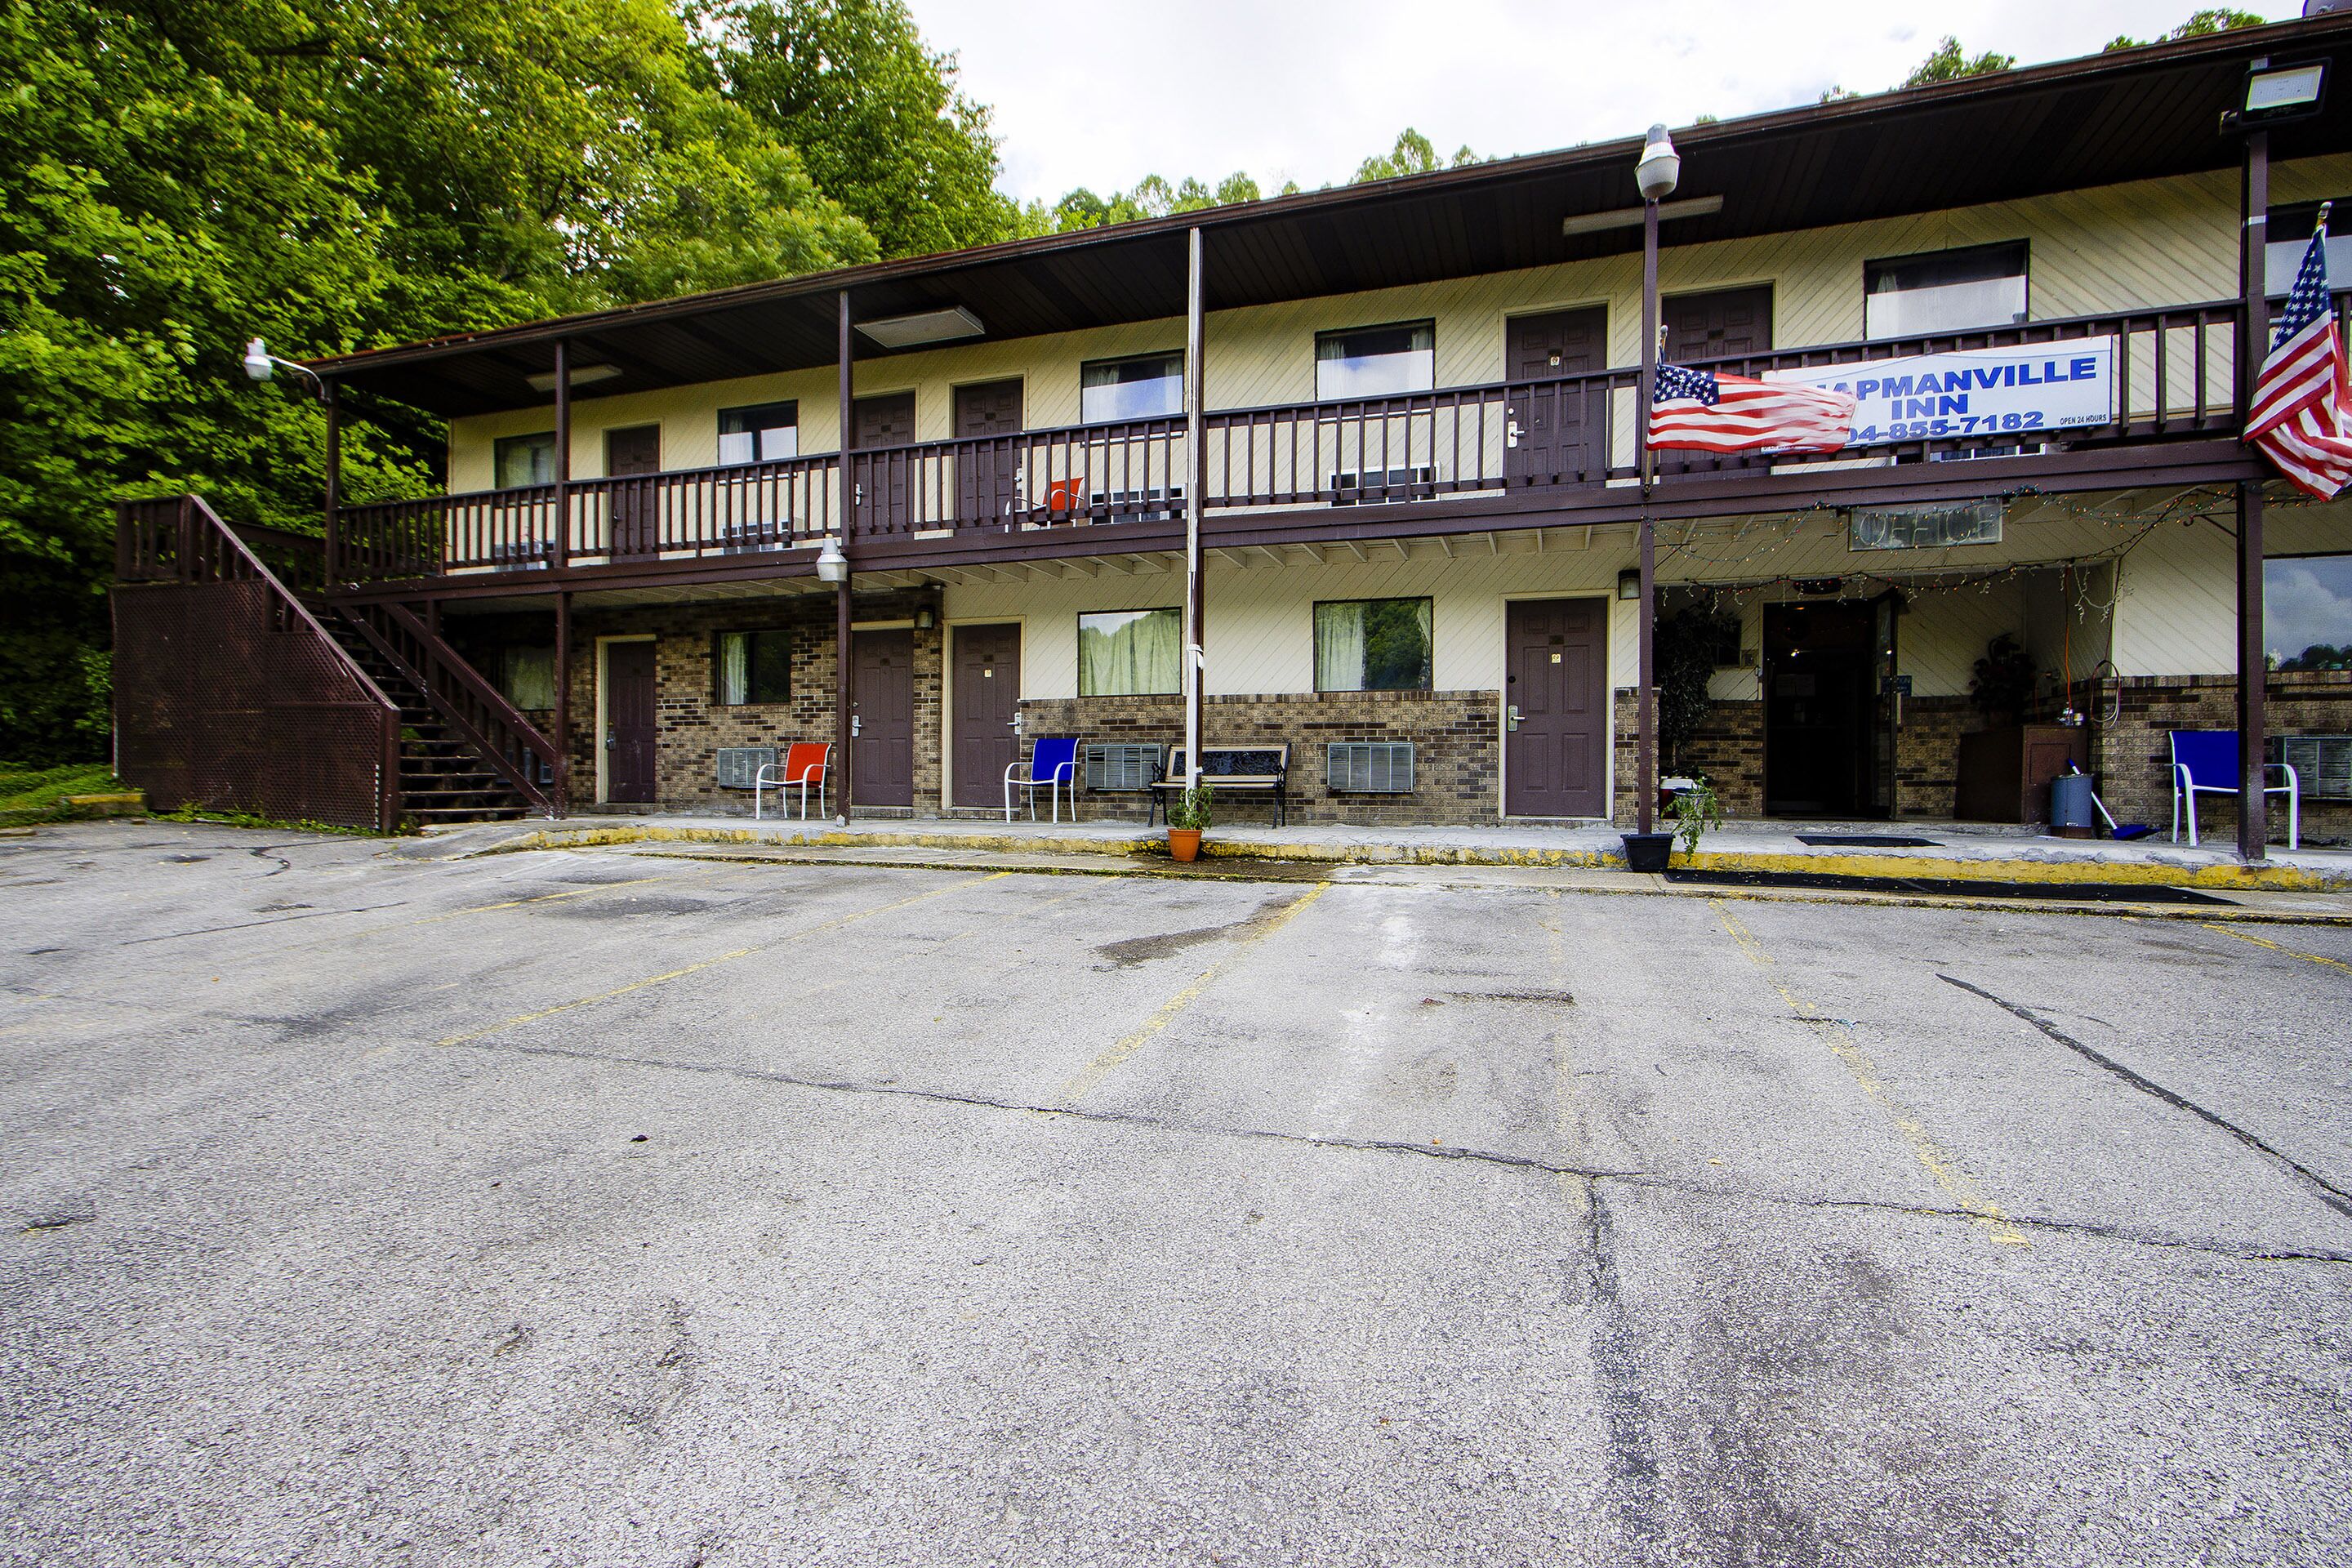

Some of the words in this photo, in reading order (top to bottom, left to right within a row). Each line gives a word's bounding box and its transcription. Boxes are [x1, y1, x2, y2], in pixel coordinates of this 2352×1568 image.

[1817, 357, 2096, 401] APMANVILLE
[1891, 394, 1968, 421] INN
[2060, 416, 2076, 425] OPEN
[2086, 414, 2107, 422] HOURS
[1848, 411, 2044, 443] 04-855-7182
[1860, 503, 1998, 546] OFFICE
